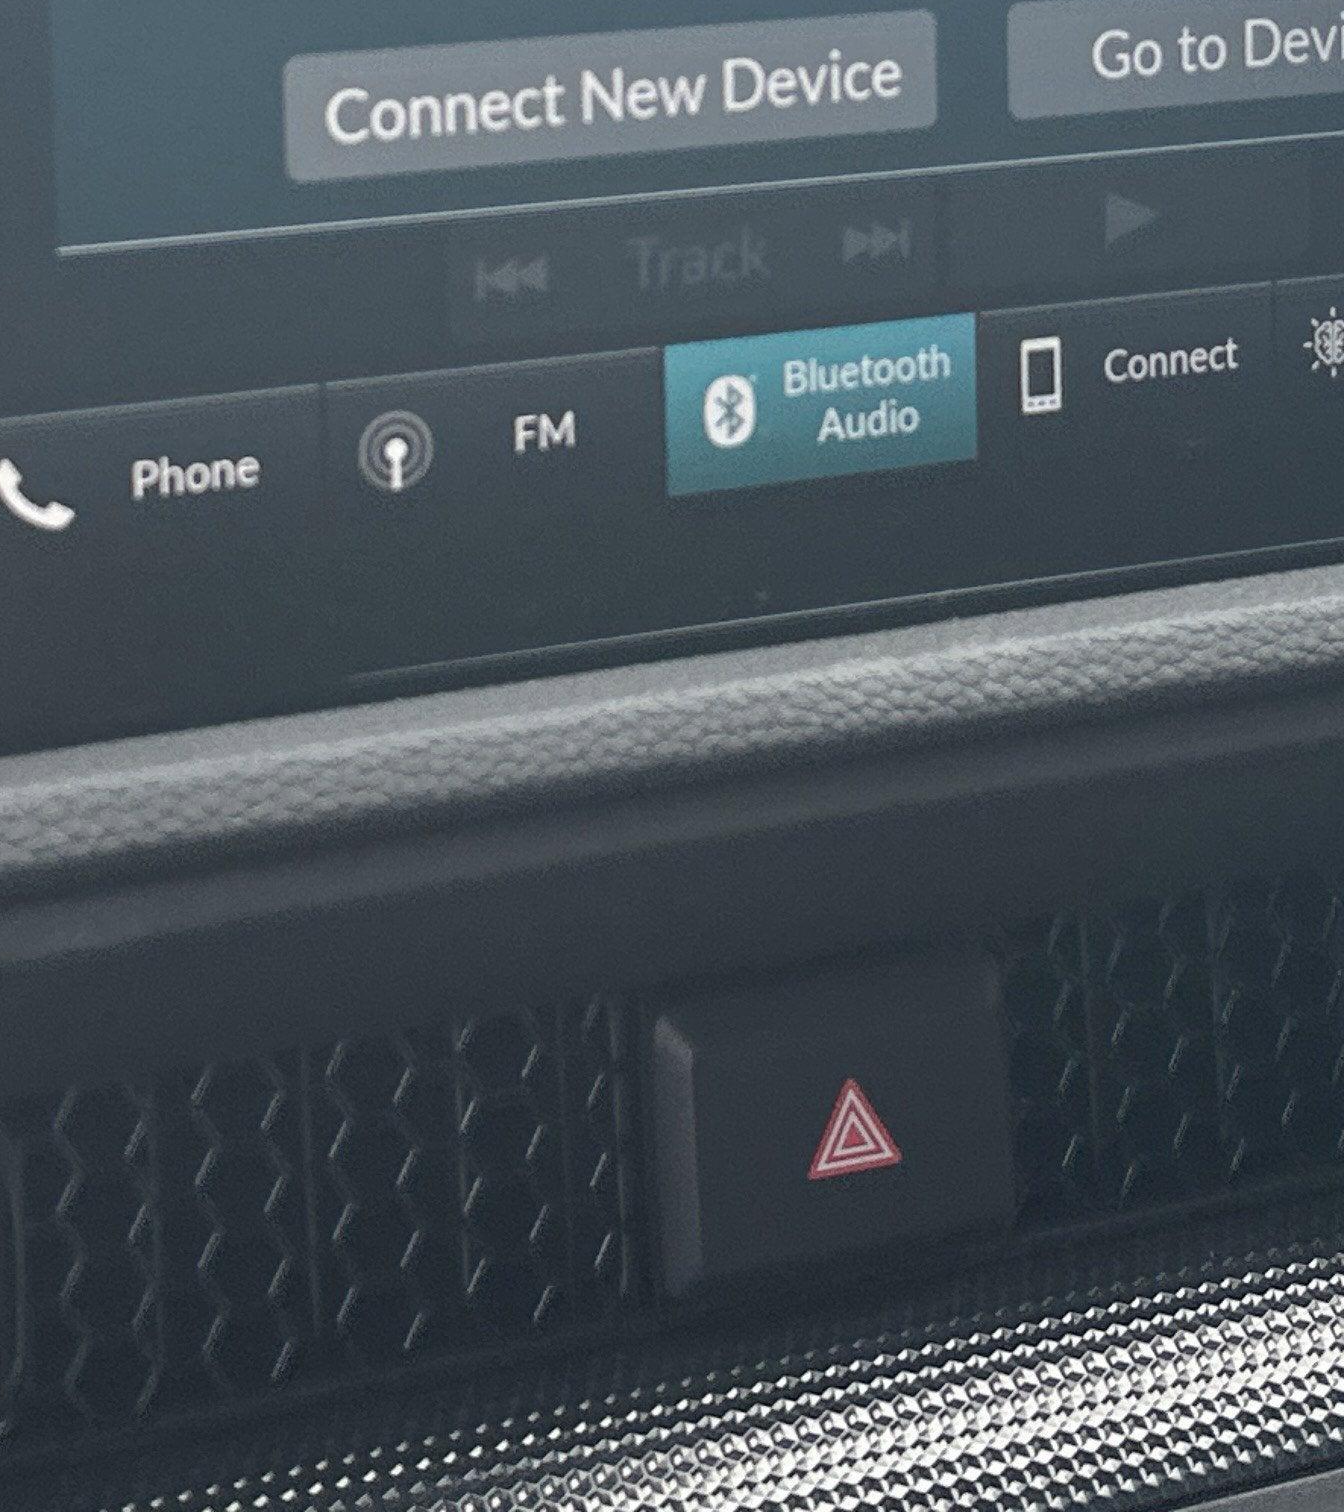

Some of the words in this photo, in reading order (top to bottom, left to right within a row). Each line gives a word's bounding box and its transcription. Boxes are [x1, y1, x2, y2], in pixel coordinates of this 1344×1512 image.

[1092, 29, 1163, 80] Go
[1180, 25, 1227, 73] to
[325, 75, 564, 145] Connect
[580, 66, 706, 125] New
[722, 48, 902, 112] Device
[627, 227, 771, 288] Track
[783, 344, 951, 398] Bluetooth
[1103, 337, 1239, 385] Connect
[513, 411, 576, 454] FM
[816, 400, 921, 444] Audio
[131, 455, 260, 500] Phone
